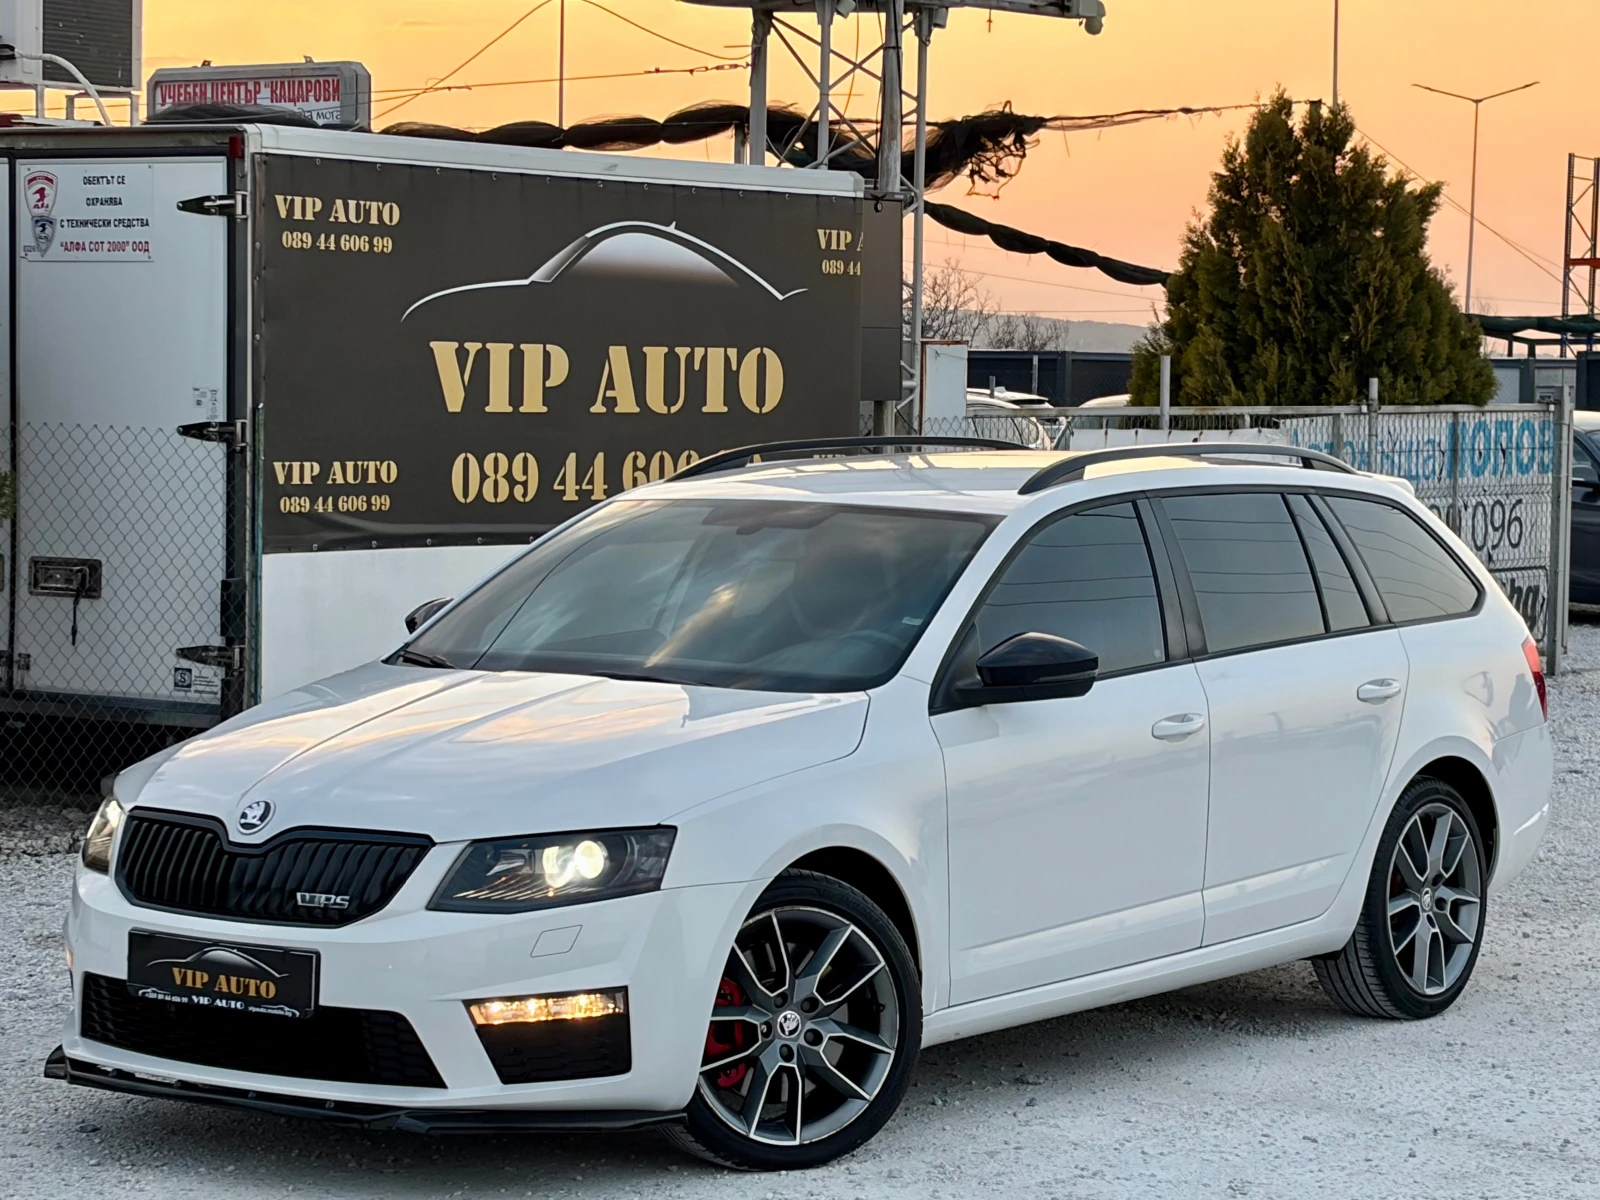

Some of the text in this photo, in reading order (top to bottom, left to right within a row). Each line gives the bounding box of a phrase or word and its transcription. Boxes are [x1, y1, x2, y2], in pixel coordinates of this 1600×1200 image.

[83, 176, 126, 185] ОБЕКТЪТ СЕ
[86, 197, 122, 206] ОХРАНЯВА
[274, 195, 400, 226] VIP AUTO
[67, 218, 111, 228] ТЕХНИЧЕСКИ
[113, 218, 149, 229] СРЕДСТВА
[89, 241, 105, 252] СОТ
[131, 241, 150, 254] ООД
[282, 231, 393, 253] 089 44 606 99
[817, 229, 852, 250] VIP
[822, 259, 845, 274] 089
[429, 341, 785, 415] VIP AUTO
[273, 460, 398, 485] VIP AUTO
[452, 452, 539, 504] 089
[553, 451, 610, 501] 44
[279, 494, 391, 513] 089 44 606 99
[1472, 498, 1523, 551] 096
[172, 967, 276, 999] VIP AUTO
[191, 995, 245, 1010] VIP AUTO
